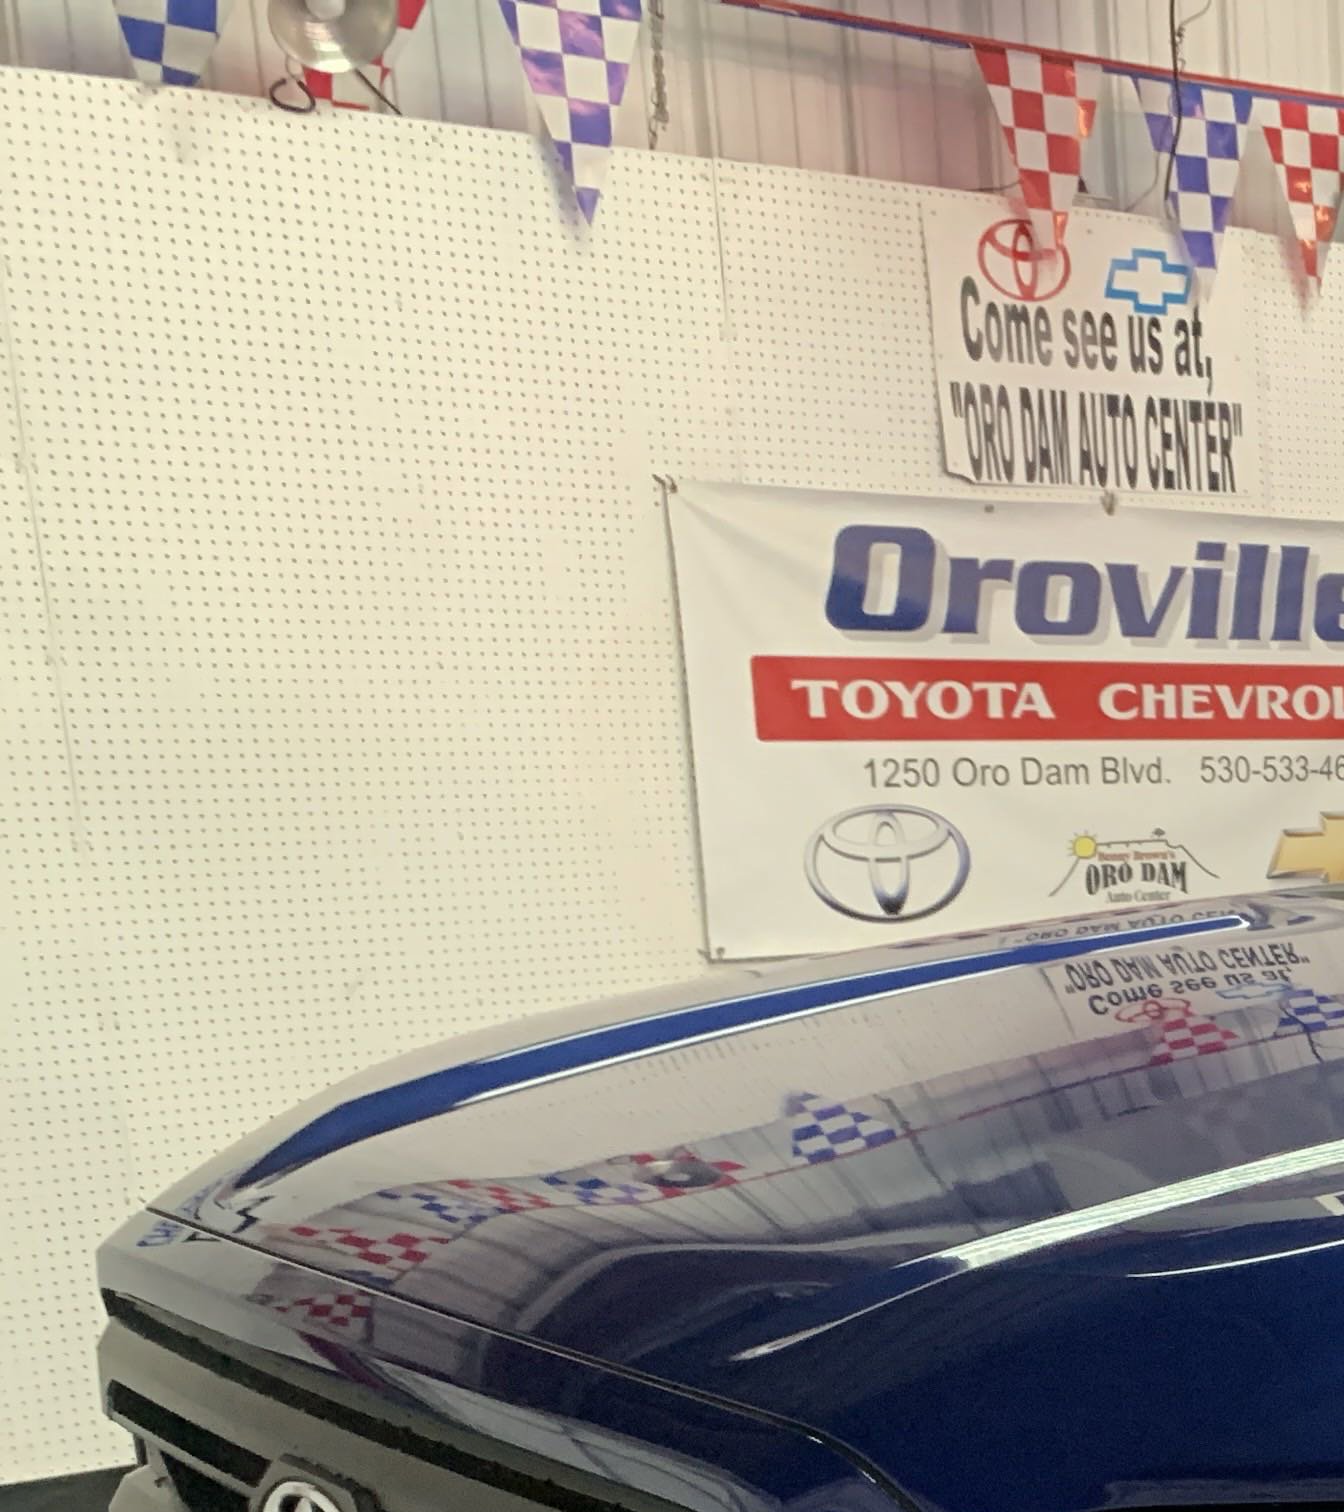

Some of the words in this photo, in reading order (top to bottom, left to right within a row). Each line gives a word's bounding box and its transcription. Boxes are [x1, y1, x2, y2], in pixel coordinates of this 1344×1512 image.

[960, 276, 1052, 366] Come
[1063, 308, 1118, 371] see
[1128, 314, 1163, 376] us
[1174, 305, 1213, 396] at,
[950, 381, 1015, 483] "ORO
[1019, 386, 1072, 485] DAM
[1079, 391, 1138, 490] AUTO
[1145, 396, 1243, 493] CENTER"
[790, 678, 1057, 721] TOYOTA
[864, 757, 940, 789] 1250
[952, 757, 1010, 788] Oro
[1022, 757, 1091, 787] Dam
[1102, 756, 1172, 786] Blvd.
[1085, 863, 1133, 895] ORO
[1141, 861, 1188, 894] DAM
